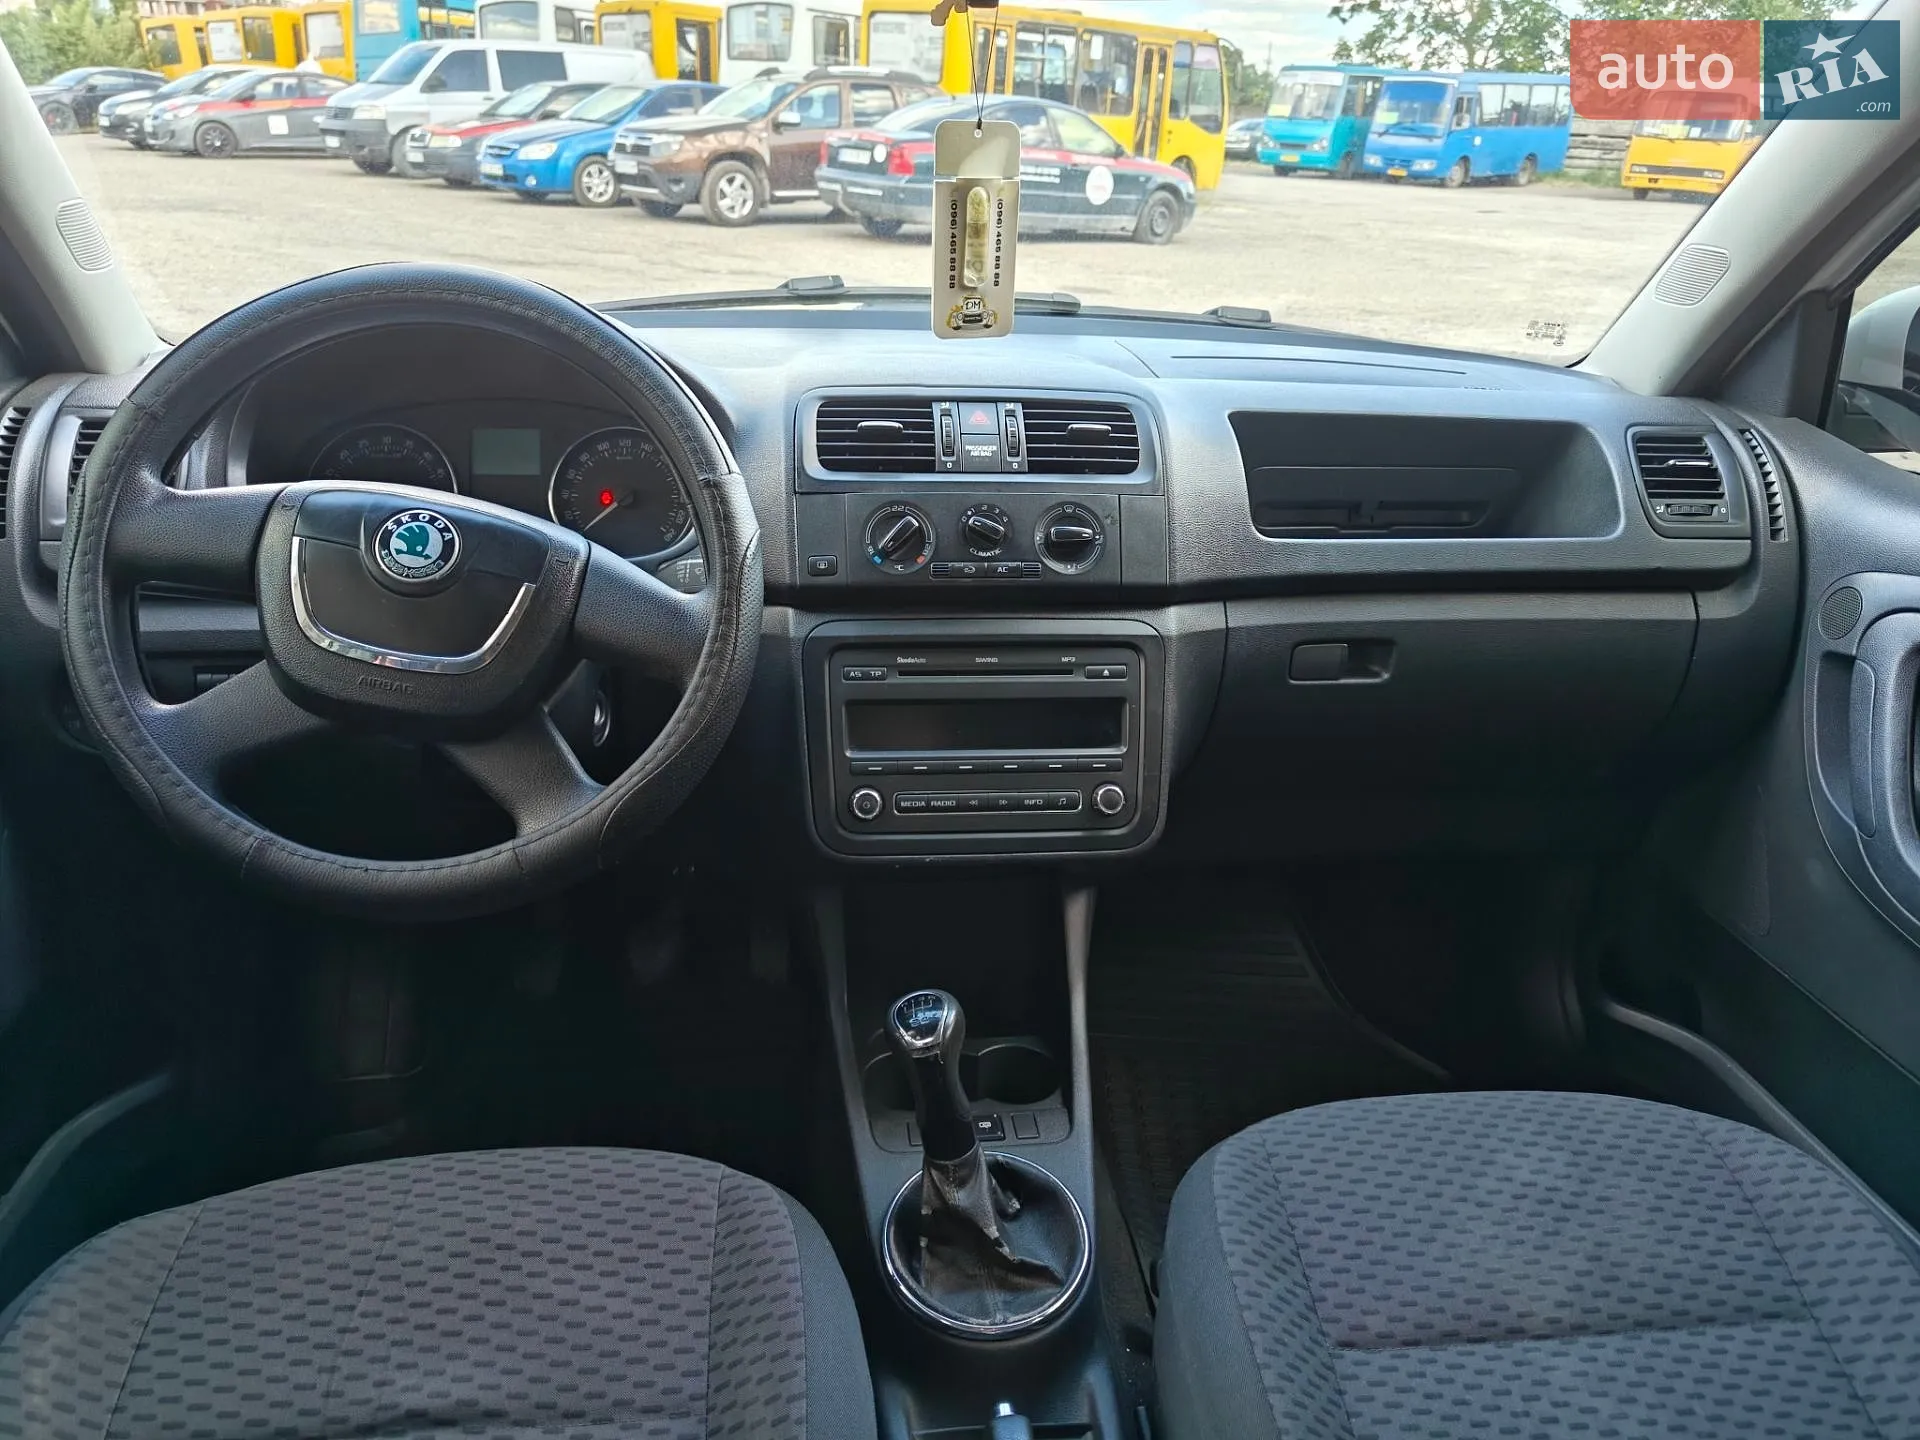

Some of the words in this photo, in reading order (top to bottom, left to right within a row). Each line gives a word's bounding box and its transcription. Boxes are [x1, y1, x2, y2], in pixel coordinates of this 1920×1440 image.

[969, 547, 1003, 557] CLIMATIC
[997, 566, 1009, 574] AC
[930, 800, 956, 808] RADIO
[1024, 798, 1043, 806] INFO
